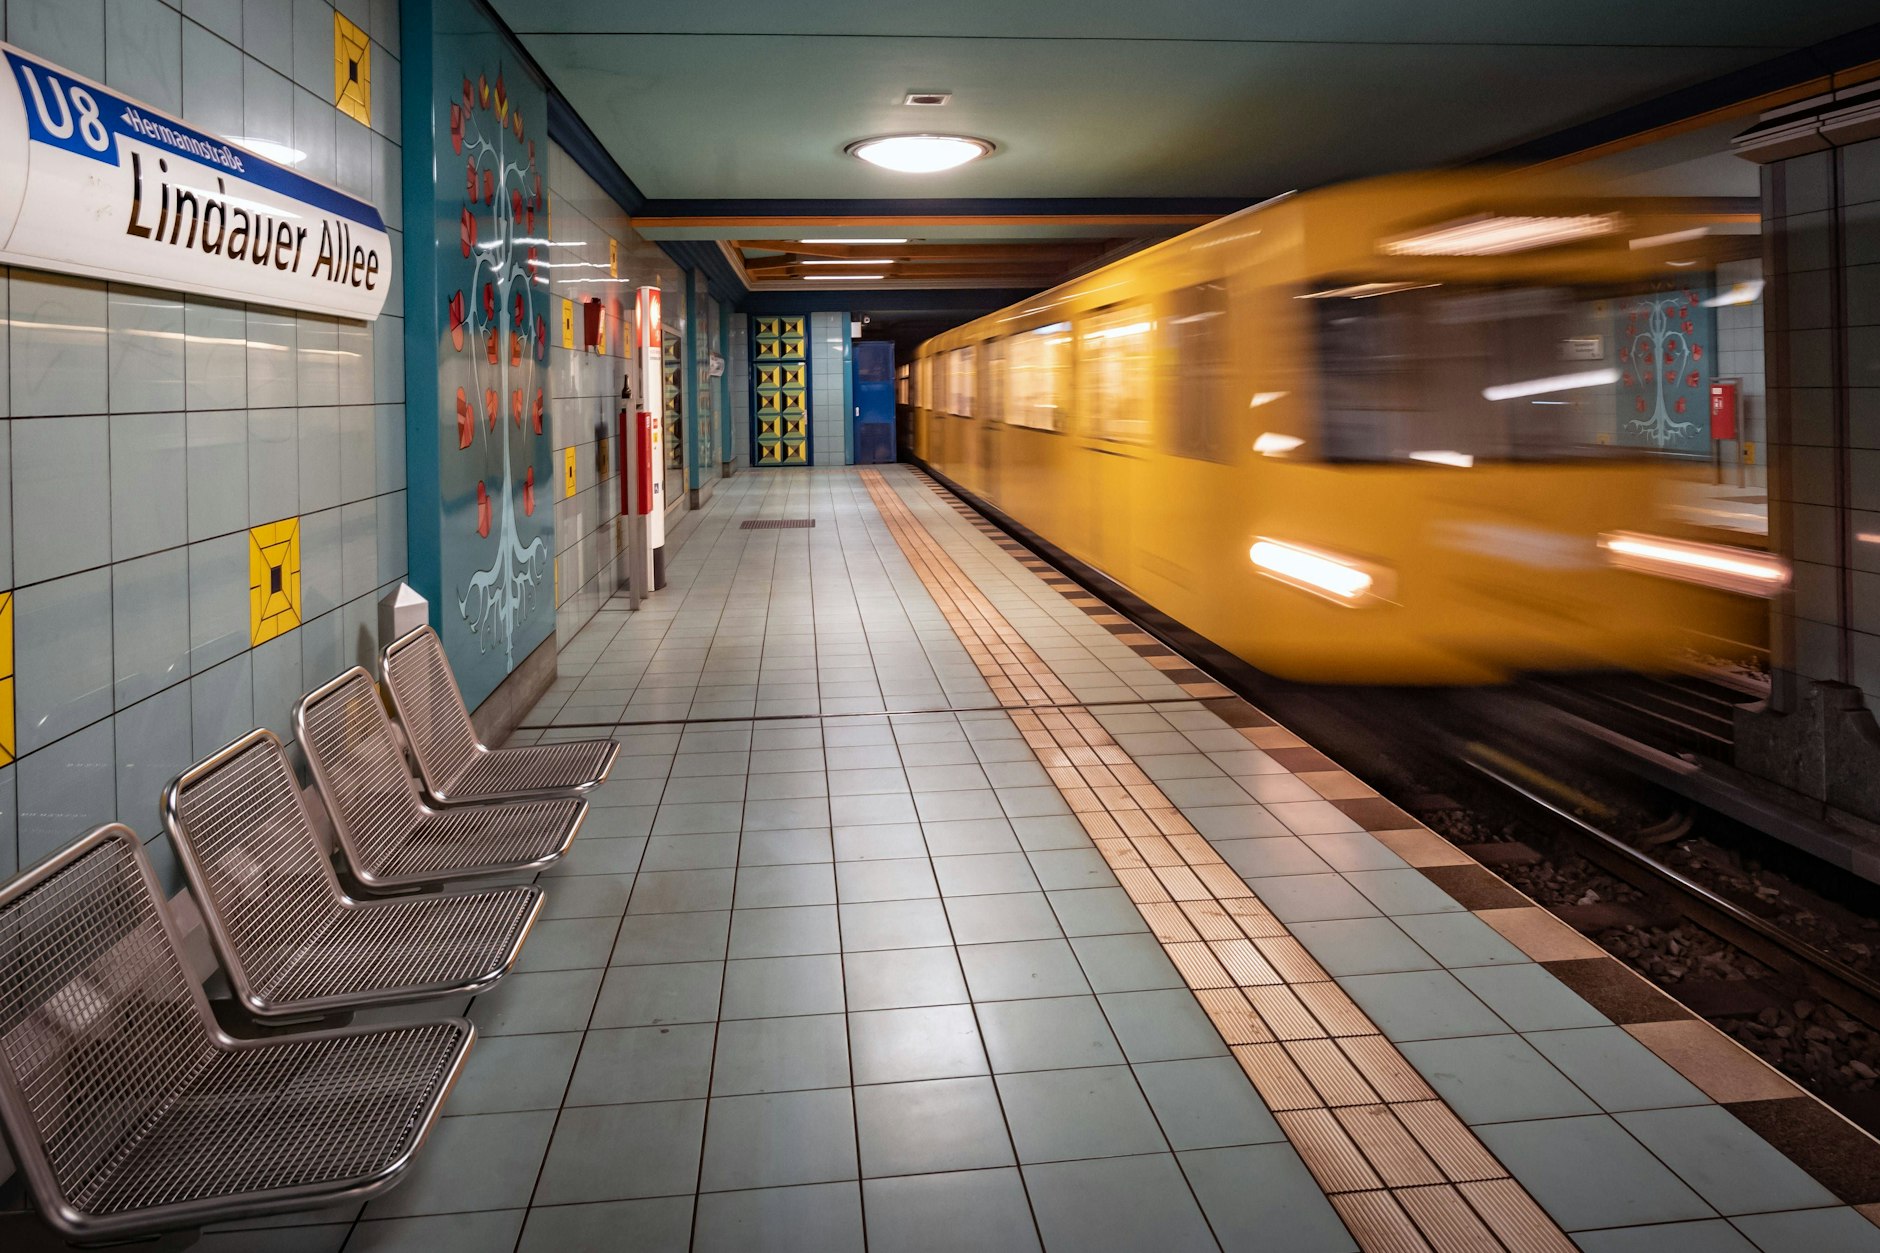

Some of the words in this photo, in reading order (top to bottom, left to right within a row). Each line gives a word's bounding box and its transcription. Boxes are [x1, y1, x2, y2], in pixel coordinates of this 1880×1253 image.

[21, 65, 110, 153] U8
[130, 107, 245, 174] Hermannstraße
[126, 151, 308, 273] Lindauer
[312, 219, 379, 291] Allee
